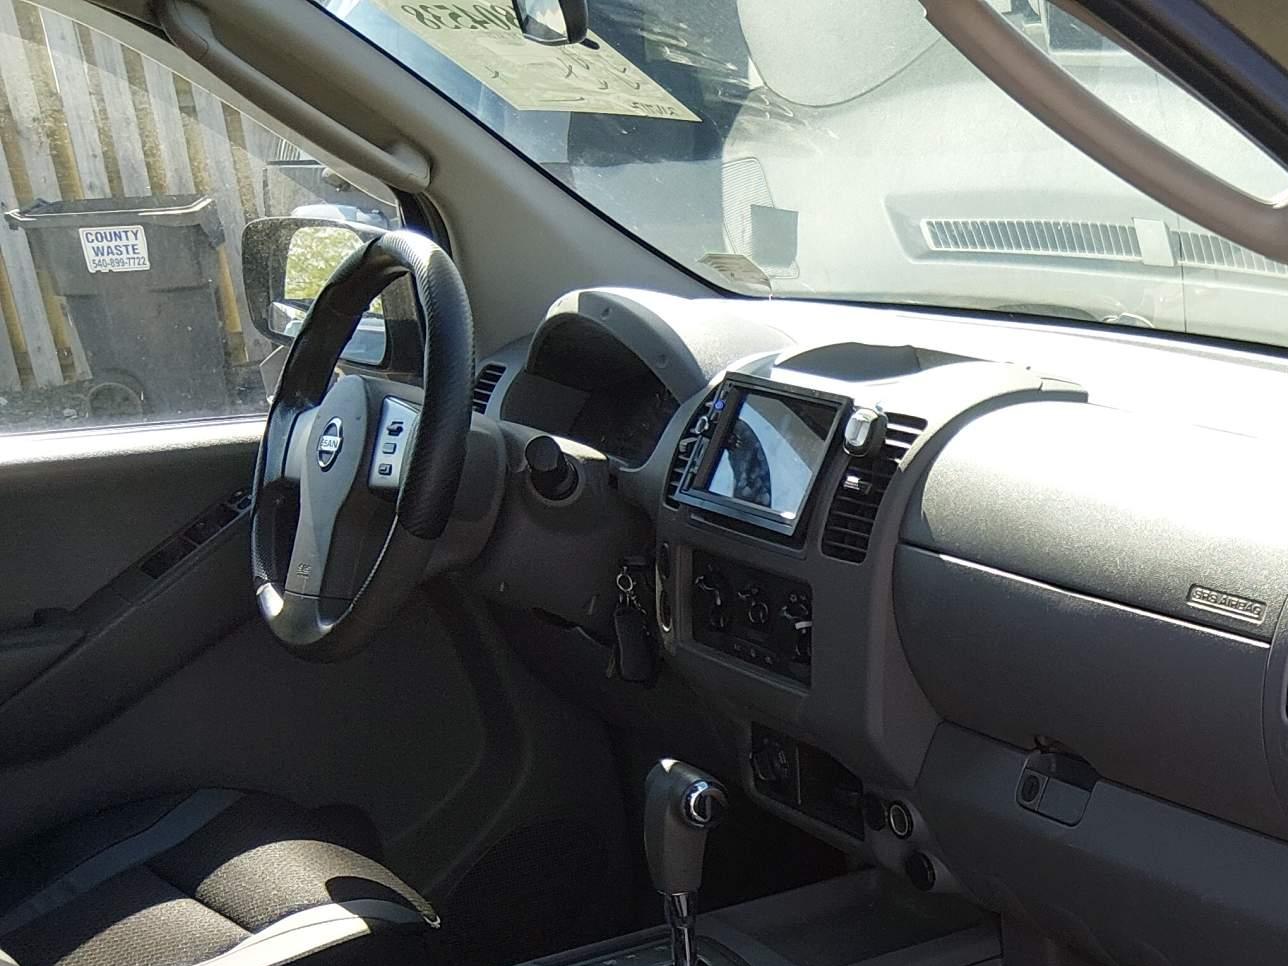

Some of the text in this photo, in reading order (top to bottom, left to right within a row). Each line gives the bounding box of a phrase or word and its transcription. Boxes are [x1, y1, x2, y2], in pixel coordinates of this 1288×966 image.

[85, 229, 139, 244] COUNTY
[91, 243, 141, 257] WASTE
[91, 255, 147, 269] 540-899-7722
[1192, 588, 1263, 615] SRS AIRBAG
